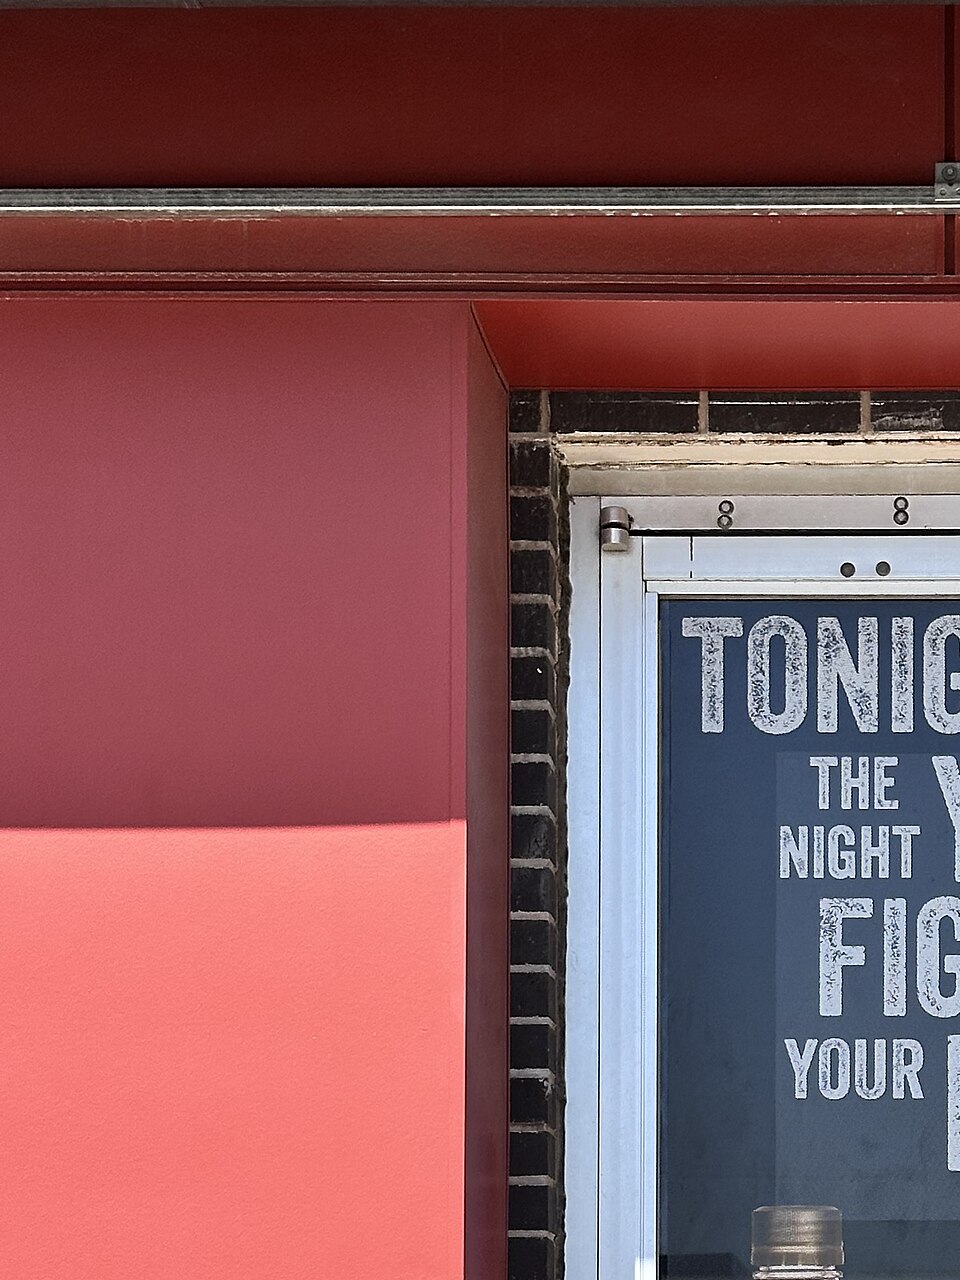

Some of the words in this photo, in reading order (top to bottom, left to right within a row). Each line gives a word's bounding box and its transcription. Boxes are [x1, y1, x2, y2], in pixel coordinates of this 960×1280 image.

[809, 756, 899, 810] THE
[778, 825, 921, 879] NIGHT
[783, 1037, 924, 1100] YOUR
